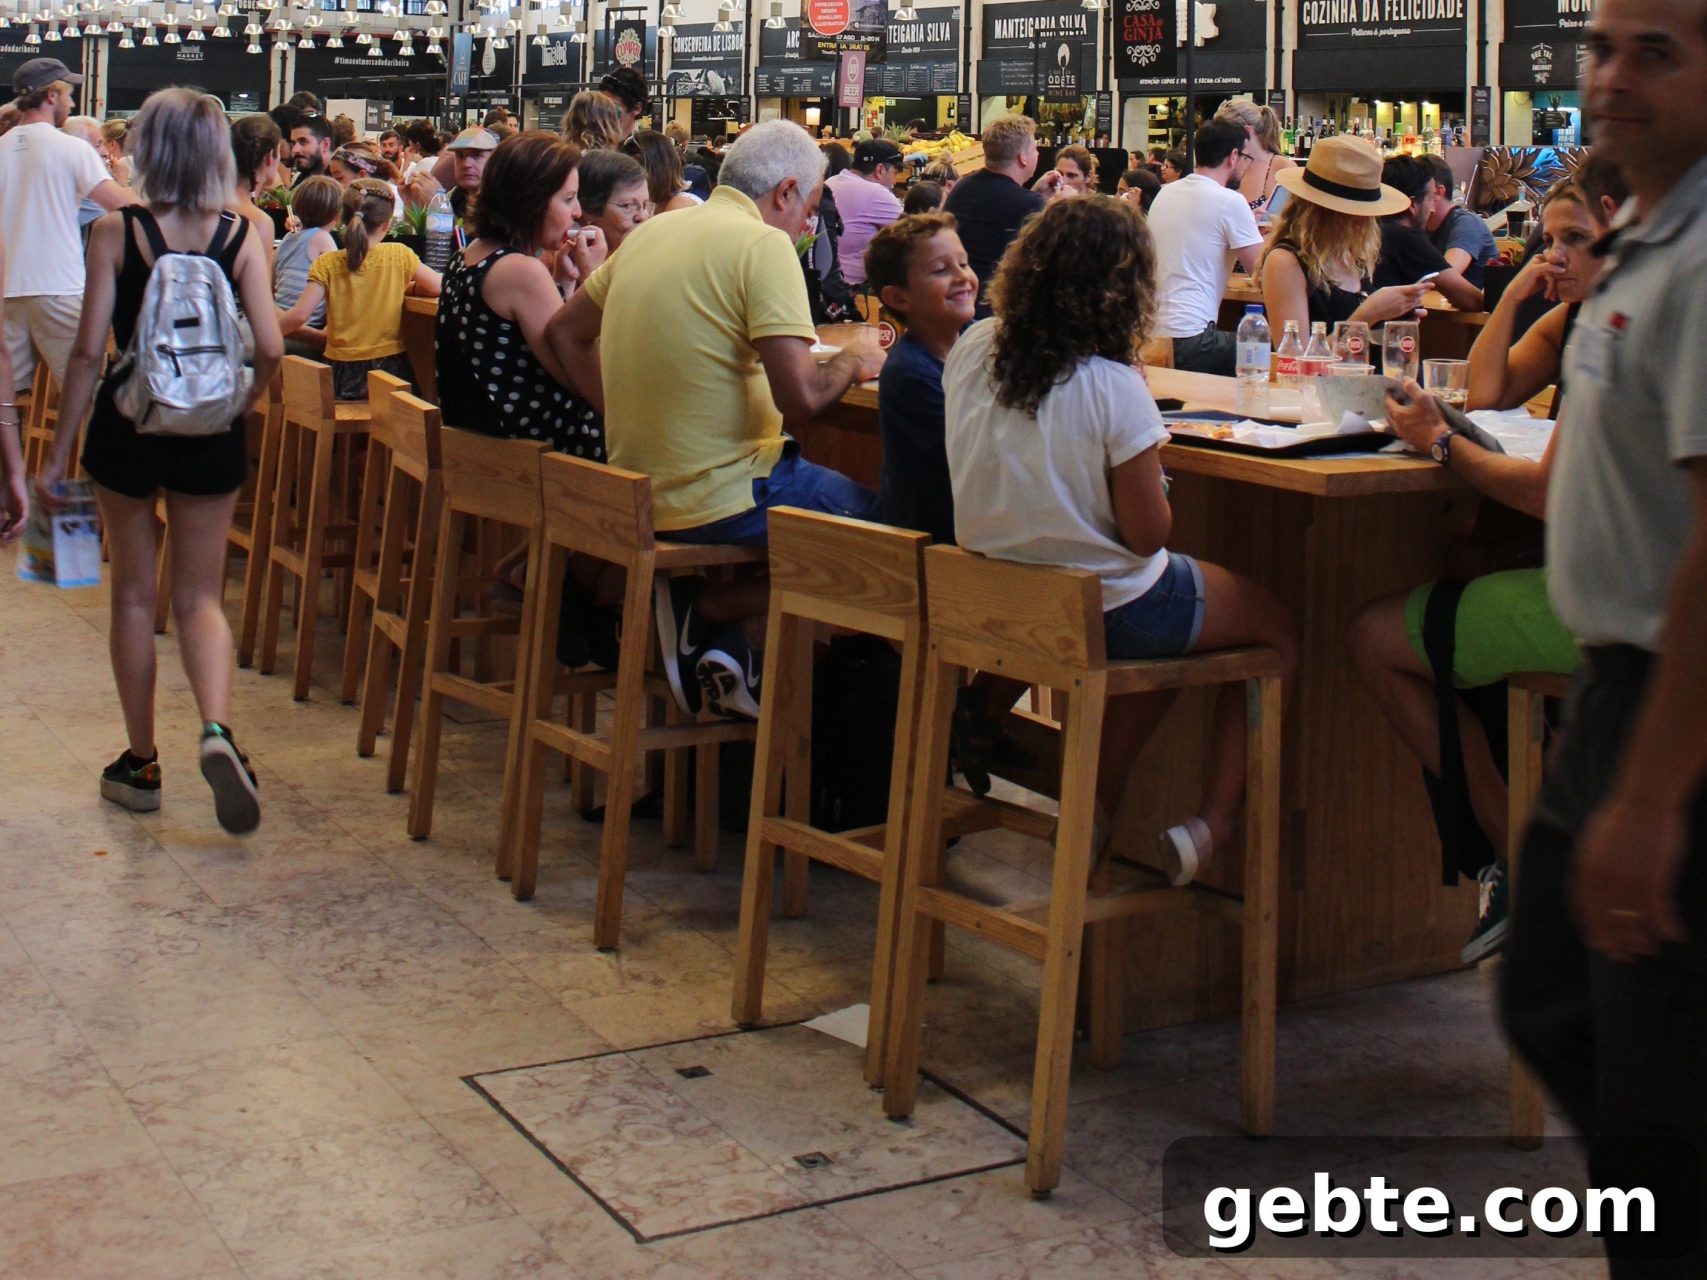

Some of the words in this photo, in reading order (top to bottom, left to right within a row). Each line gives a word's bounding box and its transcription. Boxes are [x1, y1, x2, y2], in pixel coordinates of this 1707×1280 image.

[1123, 14, 1156, 28] CASA
[927, 21, 951, 42] SILVA
[1123, 27, 1163, 43] GINJA
[673, 35, 711, 53] CONSERVEIRA
[713, 35, 721, 52] DE
